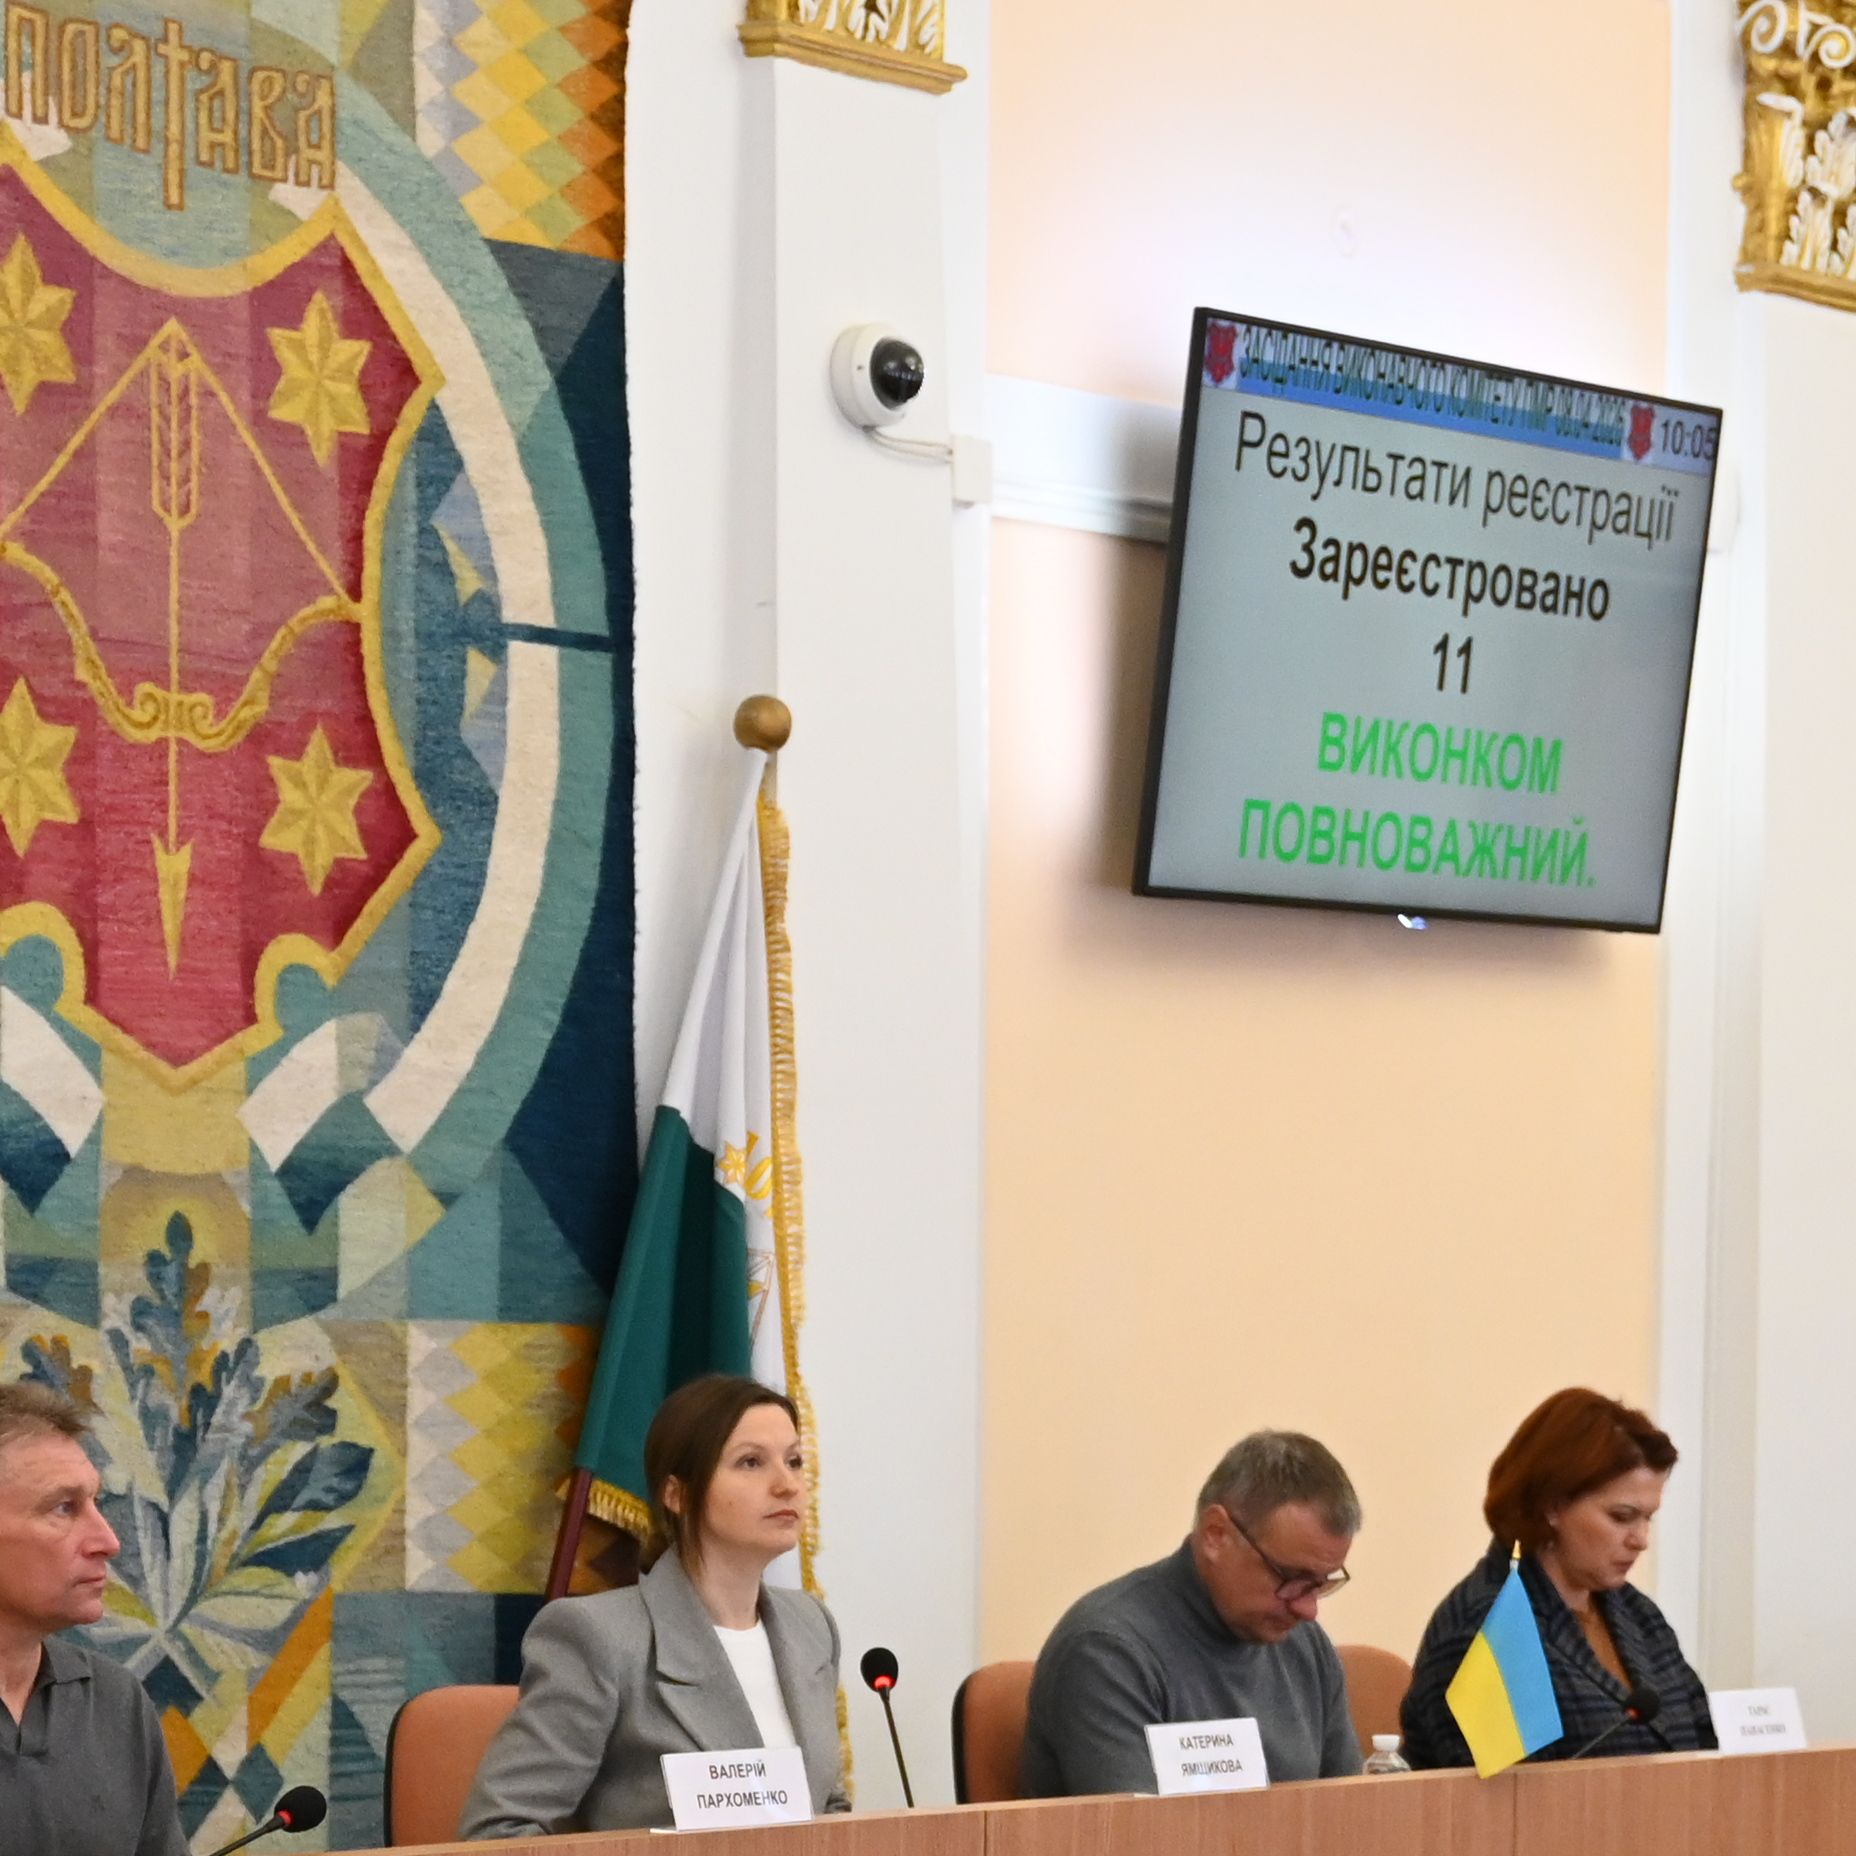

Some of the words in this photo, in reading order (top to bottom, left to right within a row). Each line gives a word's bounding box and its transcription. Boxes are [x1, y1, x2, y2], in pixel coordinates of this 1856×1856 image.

[1660, 417, 1717, 461] 10:05
[1234, 410, 1473, 508] Результати
[1482, 467, 1681, 550] реєстрації
[1289, 516, 1611, 621] Зареєстровано
[1432, 632, 1473, 694] 11
[1317, 711, 1563, 794] ВИКОНКОМ
[1238, 797, 1596, 887] ПОВНОВАЖНИЙ.
[1179, 1733, 1234, 1750] КАТЕРИНА
[1181, 1759, 1243, 1776] ЯМЩИКОВА
[709, 1760, 766, 1780] ВАЛЕРІЙ
[696, 1790, 788, 1809] ПАРХОМЕНКО
